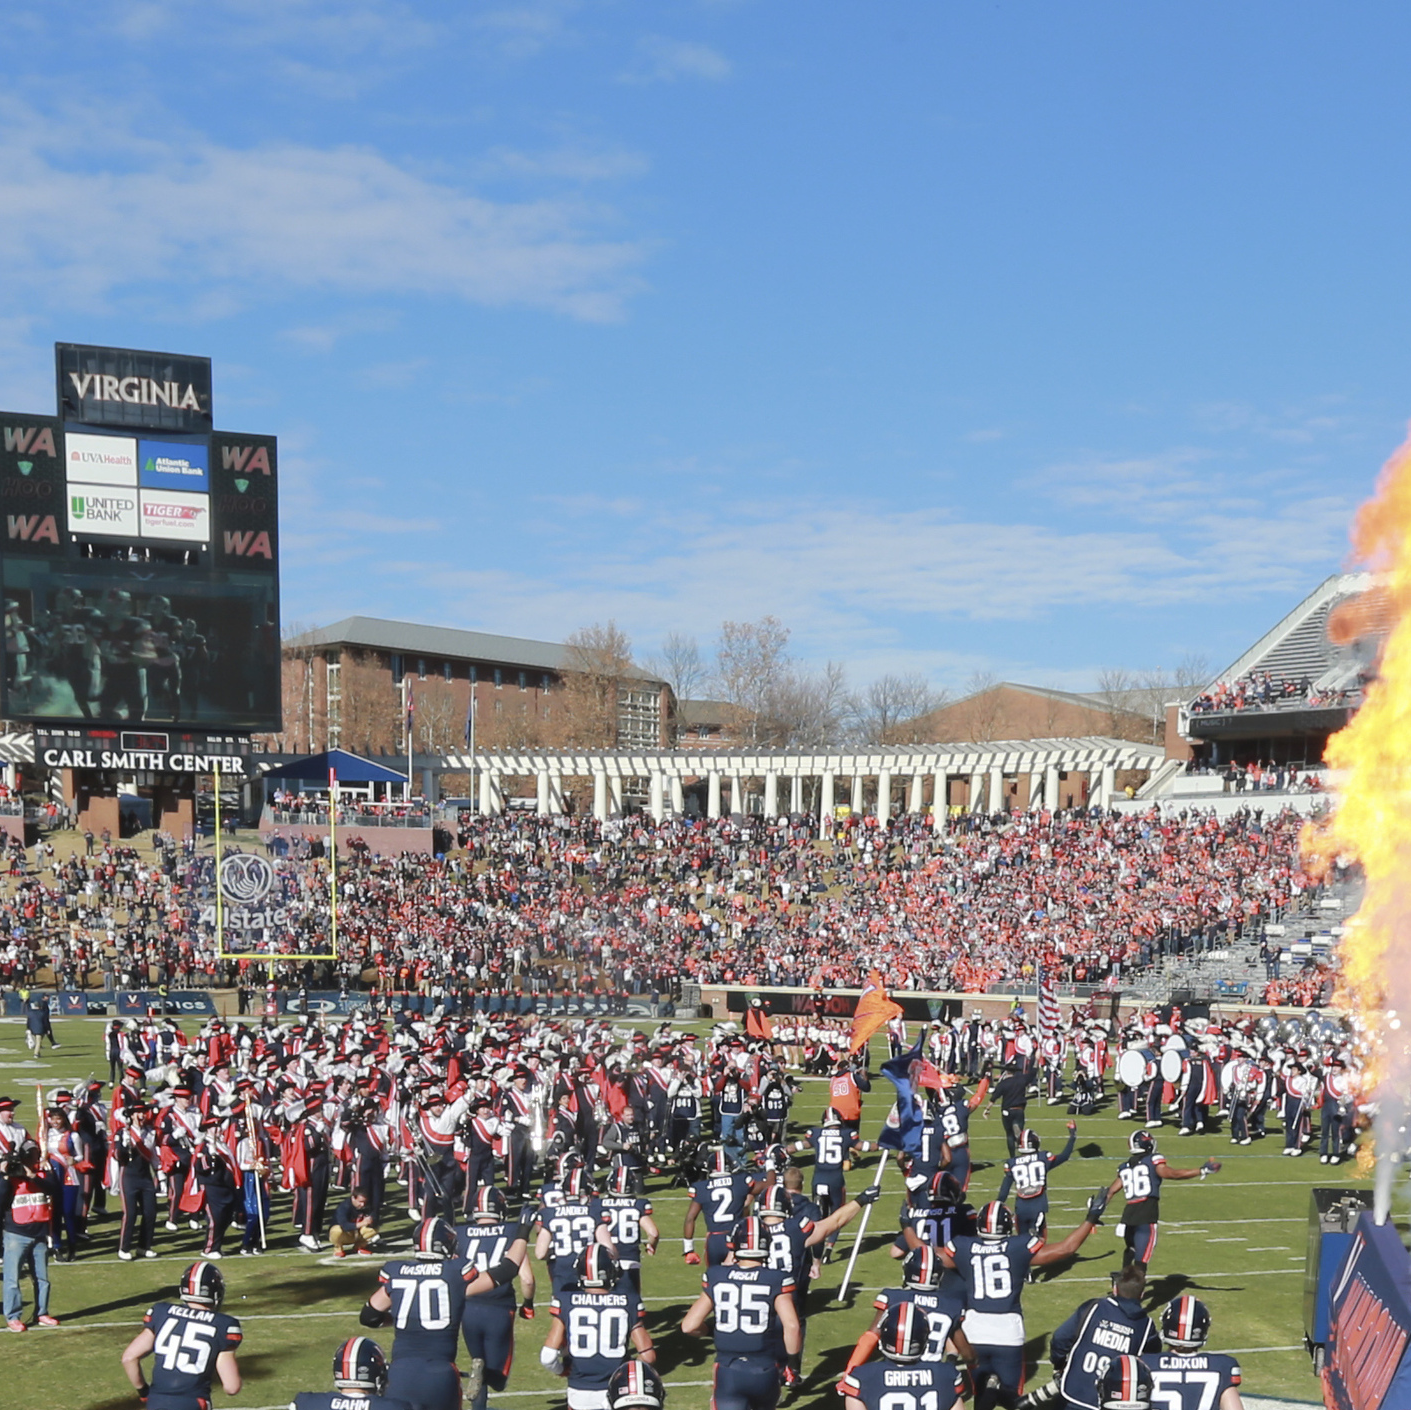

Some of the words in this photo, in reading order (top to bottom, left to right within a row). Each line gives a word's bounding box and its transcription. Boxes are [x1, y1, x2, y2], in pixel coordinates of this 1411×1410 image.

[69, 372, 200, 411] VIRGINIA
[3, 427, 57, 458] WA
[155, 457, 190, 467] Atlantic
[155, 465, 181, 475] Union
[182, 466, 203, 476] Bank
[221, 446, 271, 476] WA
[86, 496, 134, 511] UNITED
[145, 503, 183, 517] TIGER
[86, 509, 122, 522] BANK
[145, 517, 195, 528] tigerfuel.com
[6, 514, 60, 544] WA
[223, 530, 272, 559] WA
[44, 750, 96, 768] CARL
[101, 752, 165, 770] SMITH
[169, 754, 244, 773] CENTER
[817, 1136, 843, 1164] 15
[1011, 1161, 1046, 1190] 80
[1120, 1165, 1151, 1199] 86
[601, 1198, 636, 1208] DELANEY
[711, 1188, 734, 1222] 2
[914, 1208, 942, 1217] ALONSO
[467, 1225, 505, 1237] COWLEY
[548, 1216, 595, 1256] 33
[606, 1208, 640, 1244] 26
[971, 1241, 1008, 1254] BURNEY
[400, 1263, 442, 1275] HASKINS
[728, 1270, 759, 1281] MISCH
[970, 1255, 1012, 1299] 16
[391, 1279, 450, 1330] 70
[571, 1294, 628, 1306] CHALMERS
[713, 1283, 770, 1334] 85
[914, 1294, 937, 1308] KING
[168, 1304, 214, 1323] KELLAM
[568, 1307, 629, 1358] 60
[1092, 1327, 1130, 1353] MEDIA
[155, 1317, 216, 1374] 45
[1159, 1355, 1208, 1371] C.DIXON
[884, 1369, 933, 1387] GRIFFIN
